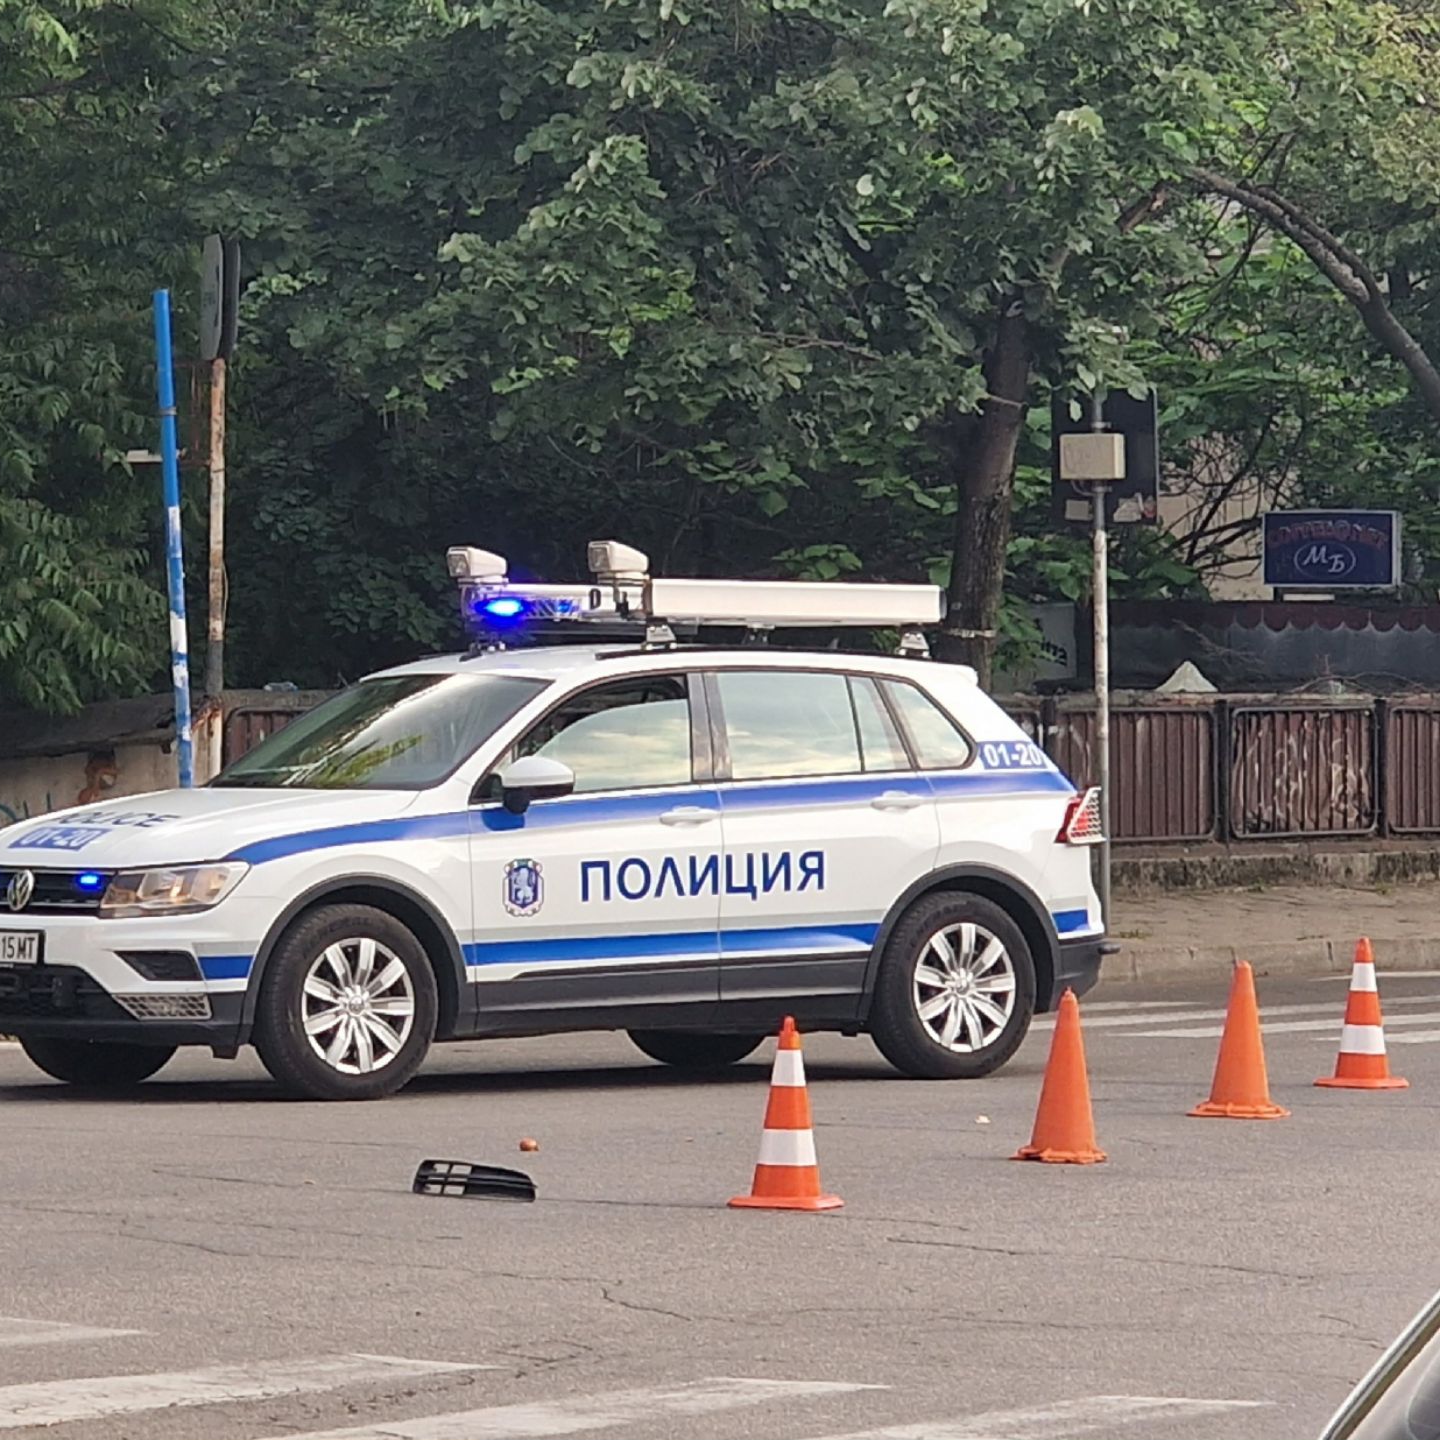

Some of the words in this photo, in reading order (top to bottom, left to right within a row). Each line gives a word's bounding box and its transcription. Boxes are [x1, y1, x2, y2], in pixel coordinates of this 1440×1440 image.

[983, 743, 1042, 767] 01-20
[19, 827, 102, 848] 01-20
[579, 850, 826, 902] ПОЛИЦИЯ
